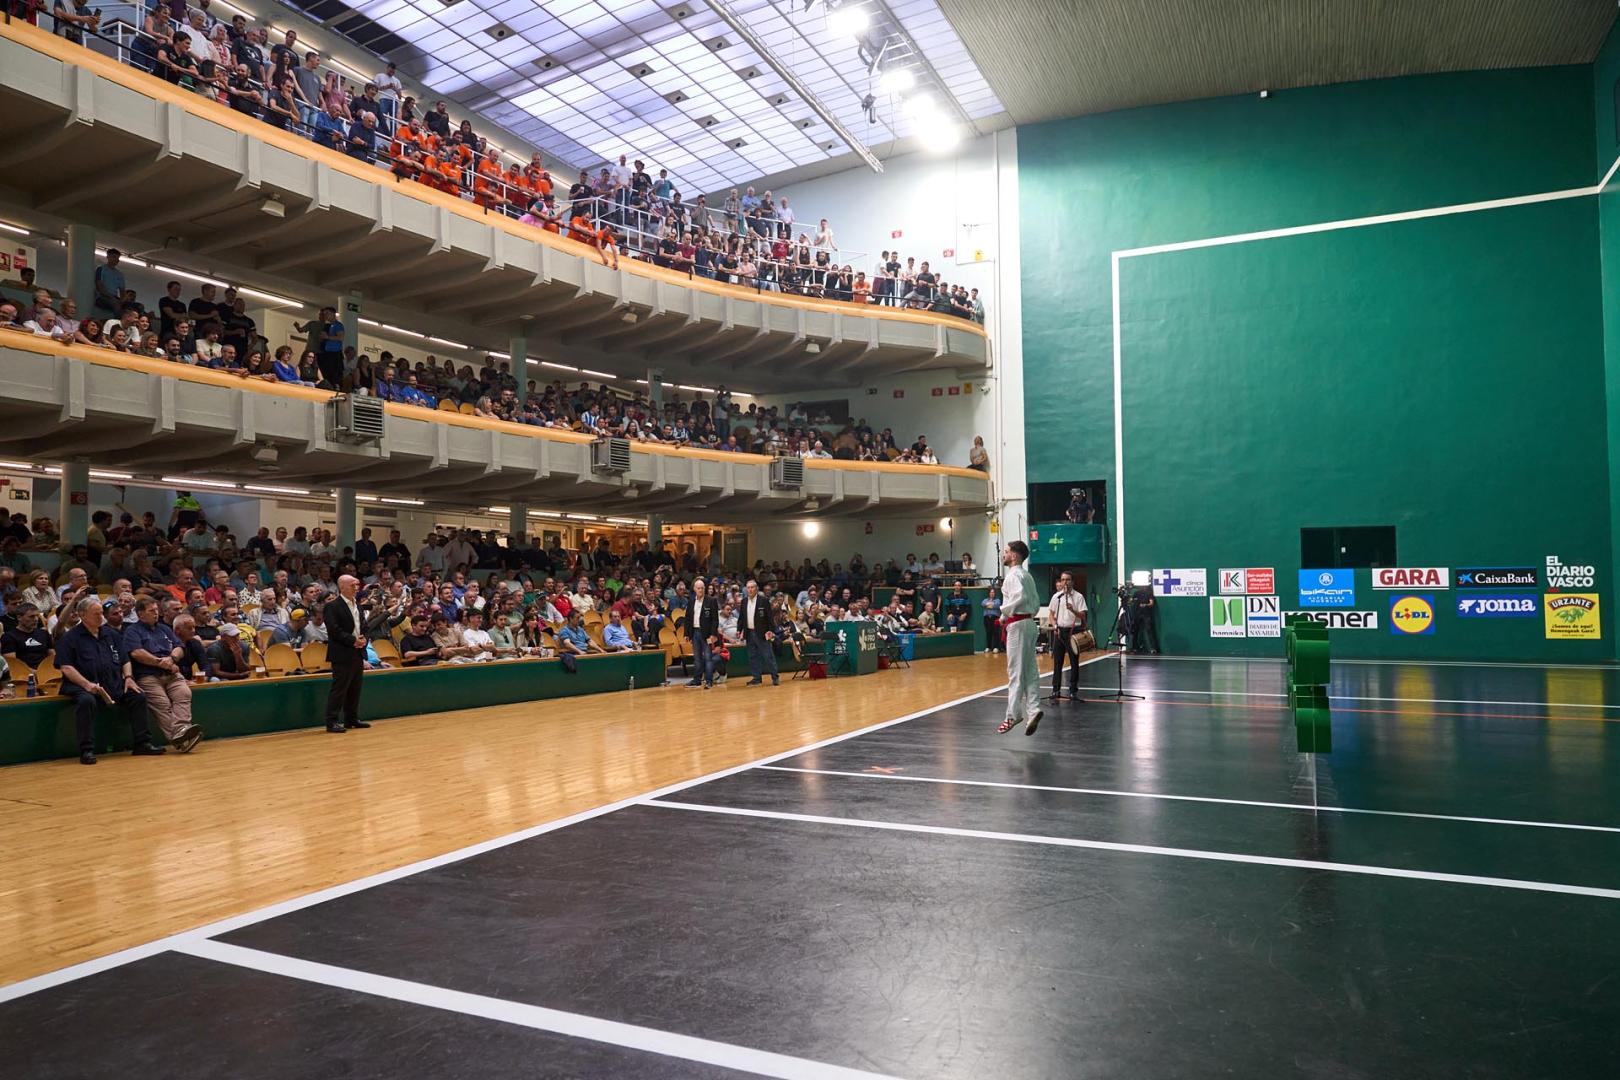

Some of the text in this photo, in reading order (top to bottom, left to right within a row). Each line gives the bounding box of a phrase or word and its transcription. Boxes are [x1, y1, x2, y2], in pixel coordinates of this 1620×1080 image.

[1546, 555, 1563, 566] EL
[1546, 566, 1595, 577] DIARIO
[1379, 569, 1441, 586] GARA
[1475, 573, 1535, 584] CaixaBank
[1547, 577, 1594, 587] VASCO
[1249, 597, 1277, 613] DN
[1551, 598, 1592, 608] URZANTE
[1284, 612, 1374, 628] sner
